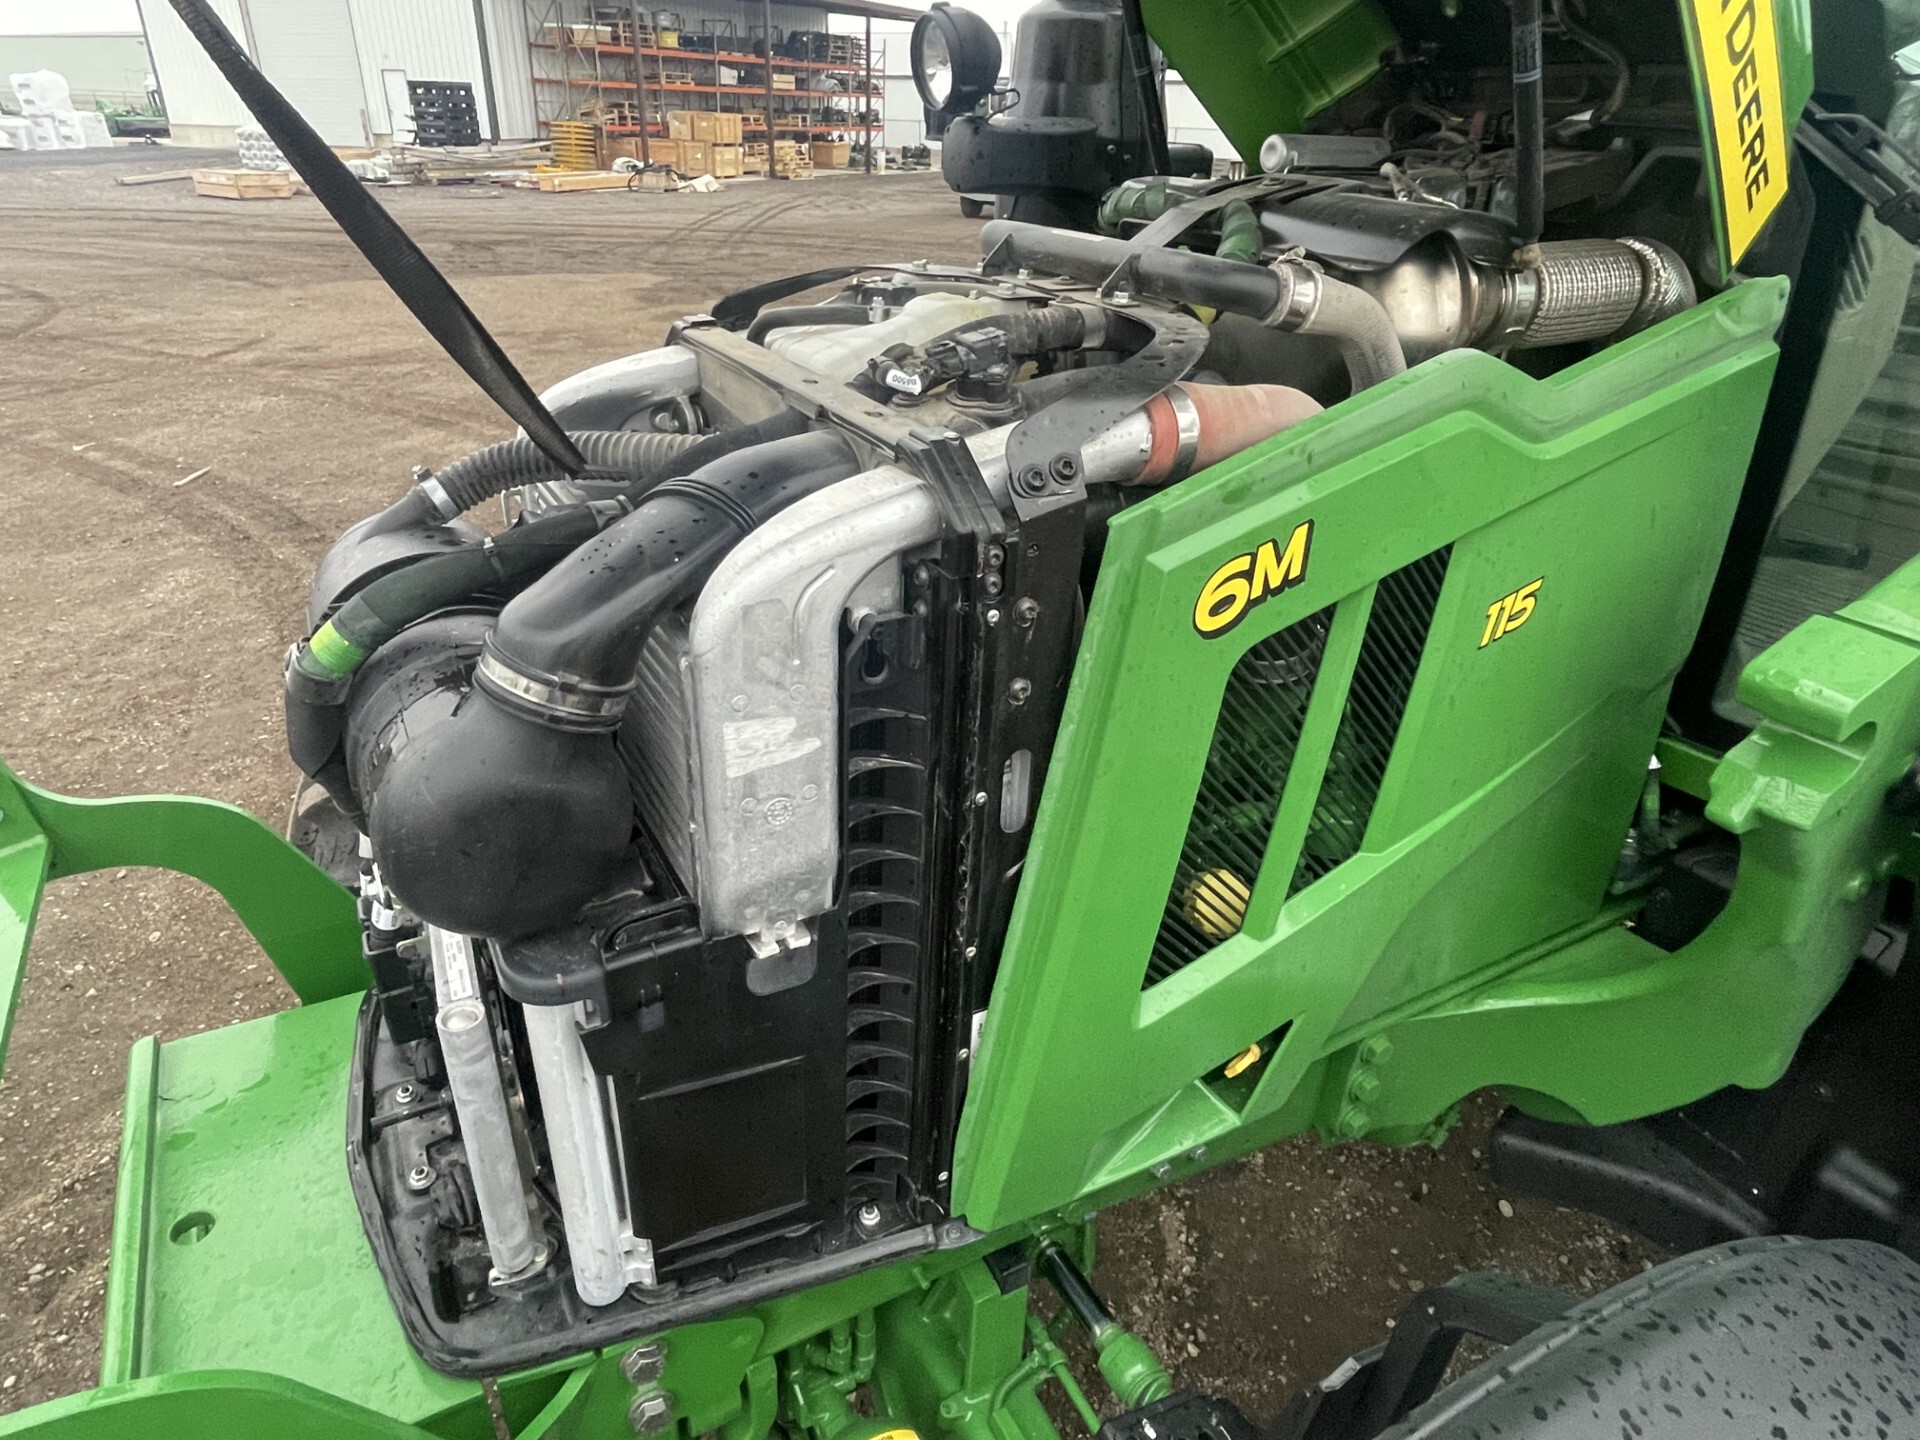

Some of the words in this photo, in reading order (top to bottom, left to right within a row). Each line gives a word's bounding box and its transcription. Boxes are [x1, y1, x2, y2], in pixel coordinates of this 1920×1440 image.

[1726, 0, 1770, 213] DEERE
[1193, 518, 1315, 640] 6M
[1477, 575, 1545, 650] 115
